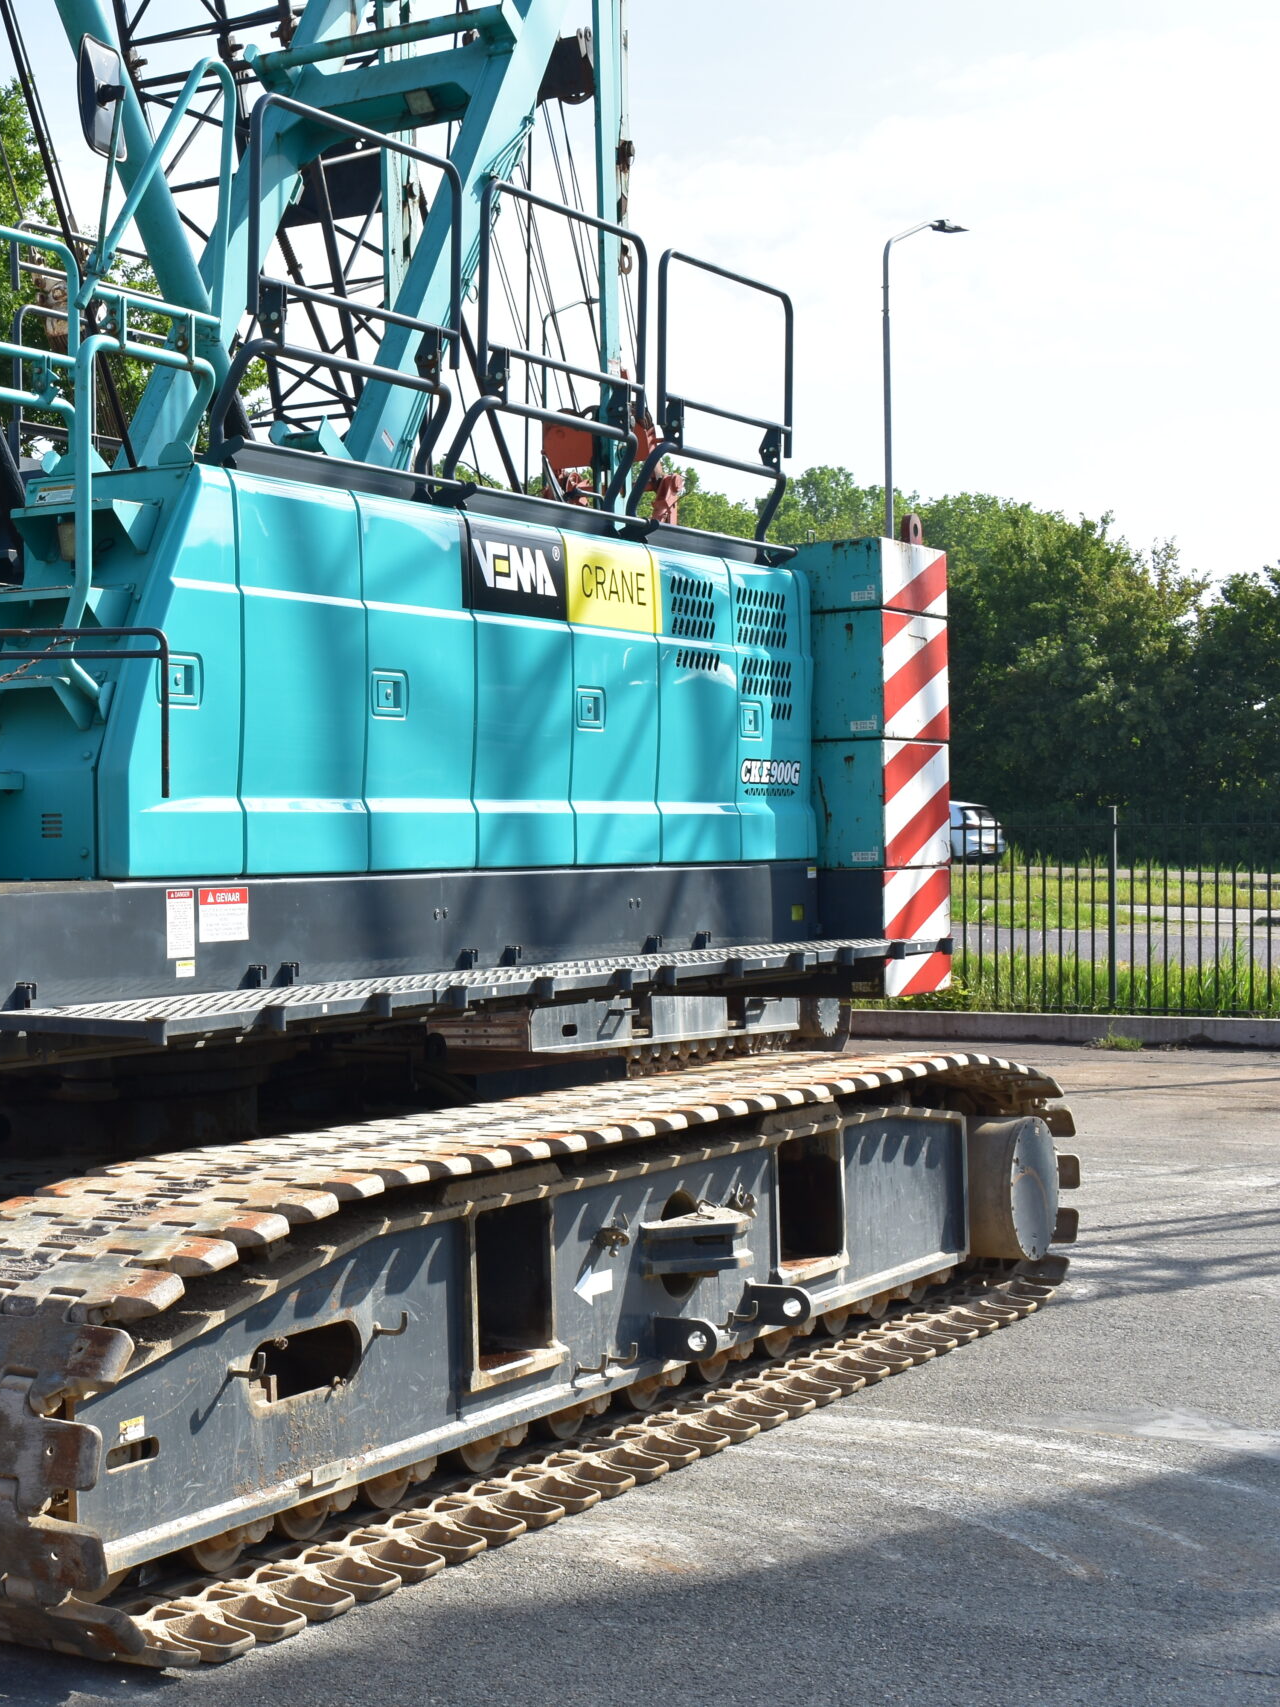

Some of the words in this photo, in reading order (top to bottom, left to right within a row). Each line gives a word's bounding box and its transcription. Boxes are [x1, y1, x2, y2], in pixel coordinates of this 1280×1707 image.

[581, 563, 647, 606] CRANE
[740, 758, 801, 786] CKE900G
[215, 892, 241, 903] GEVAAR
